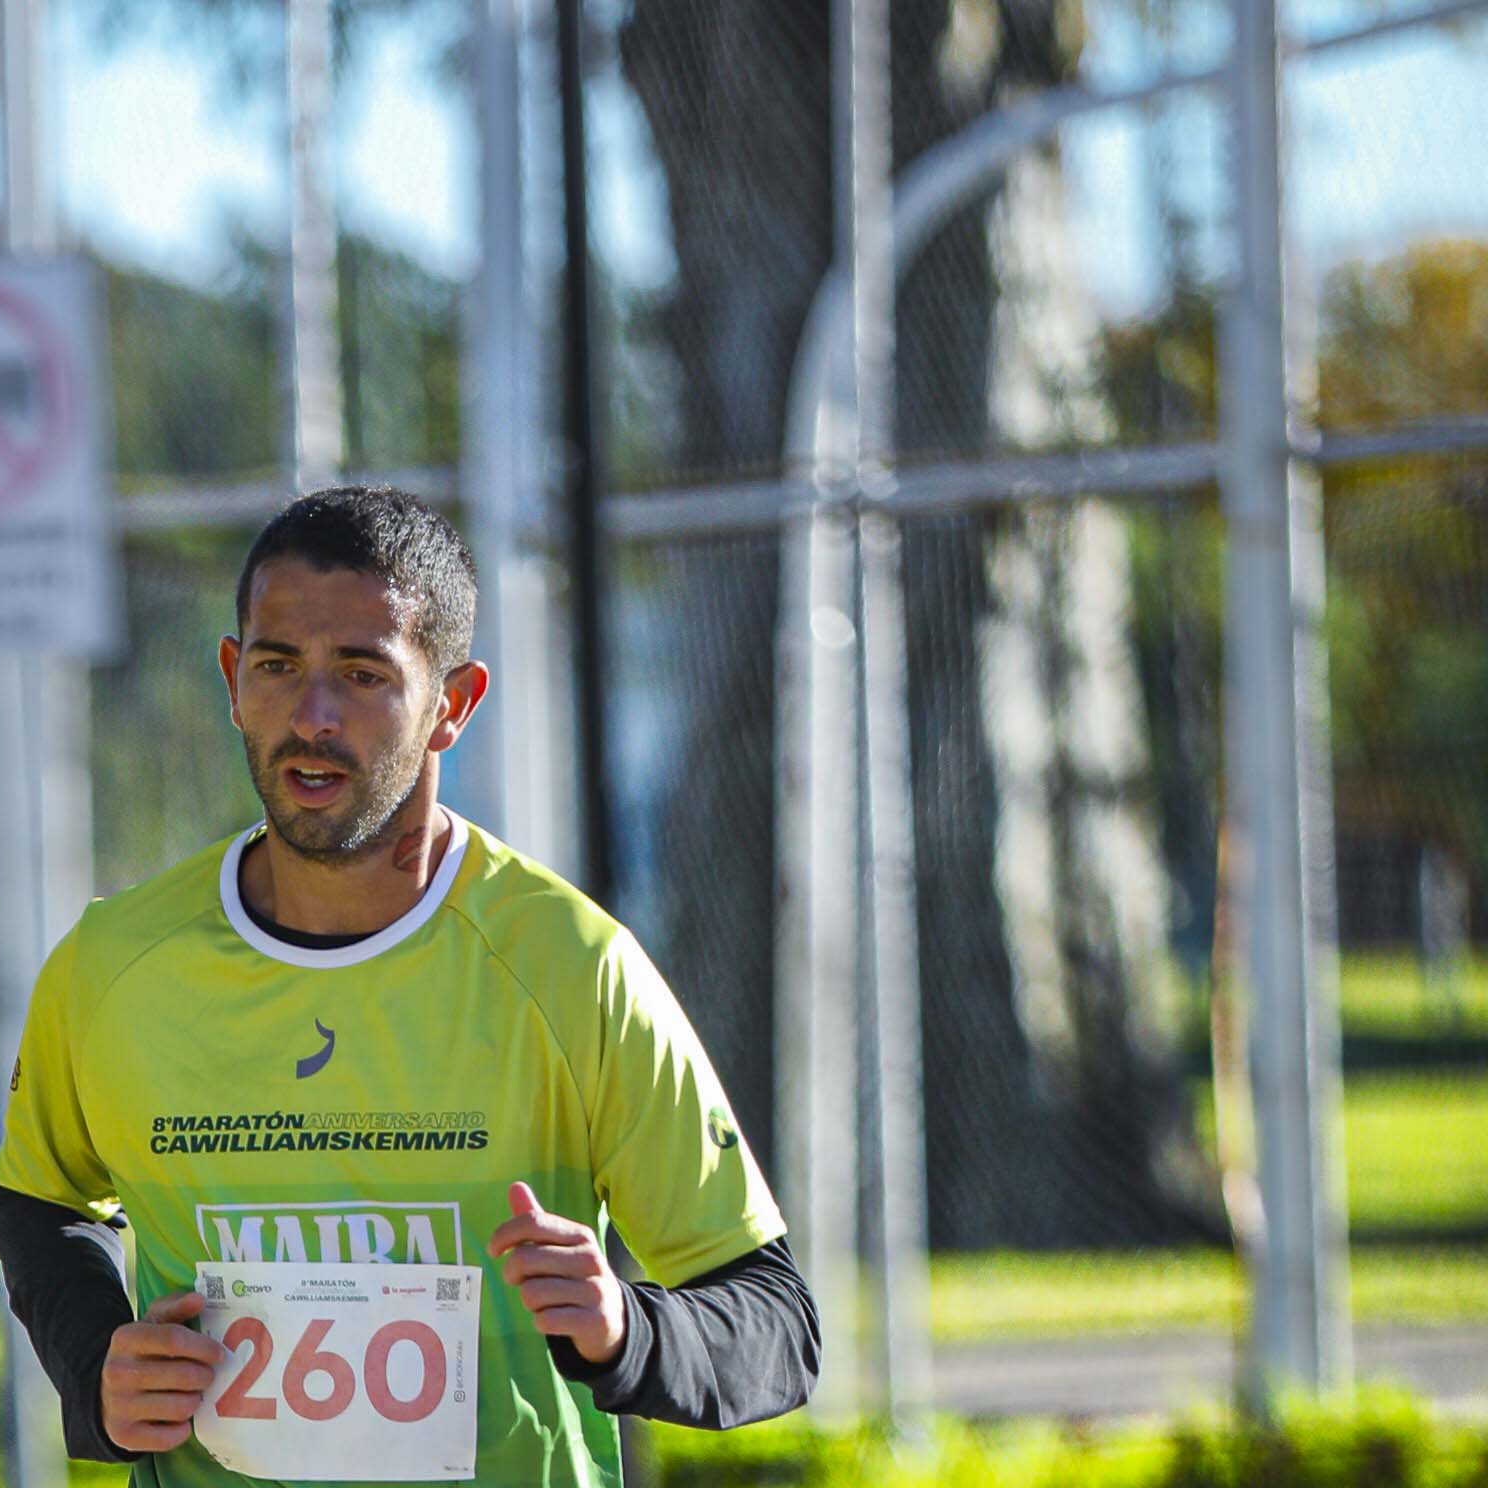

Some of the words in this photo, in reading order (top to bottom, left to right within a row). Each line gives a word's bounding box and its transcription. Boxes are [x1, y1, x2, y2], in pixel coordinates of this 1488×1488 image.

[305, 1111, 487, 1129] ANIVERSARIO
[151, 1130, 489, 1154] CAWILLIAMSKEMMIS
[215, 1316, 447, 1423] 260
